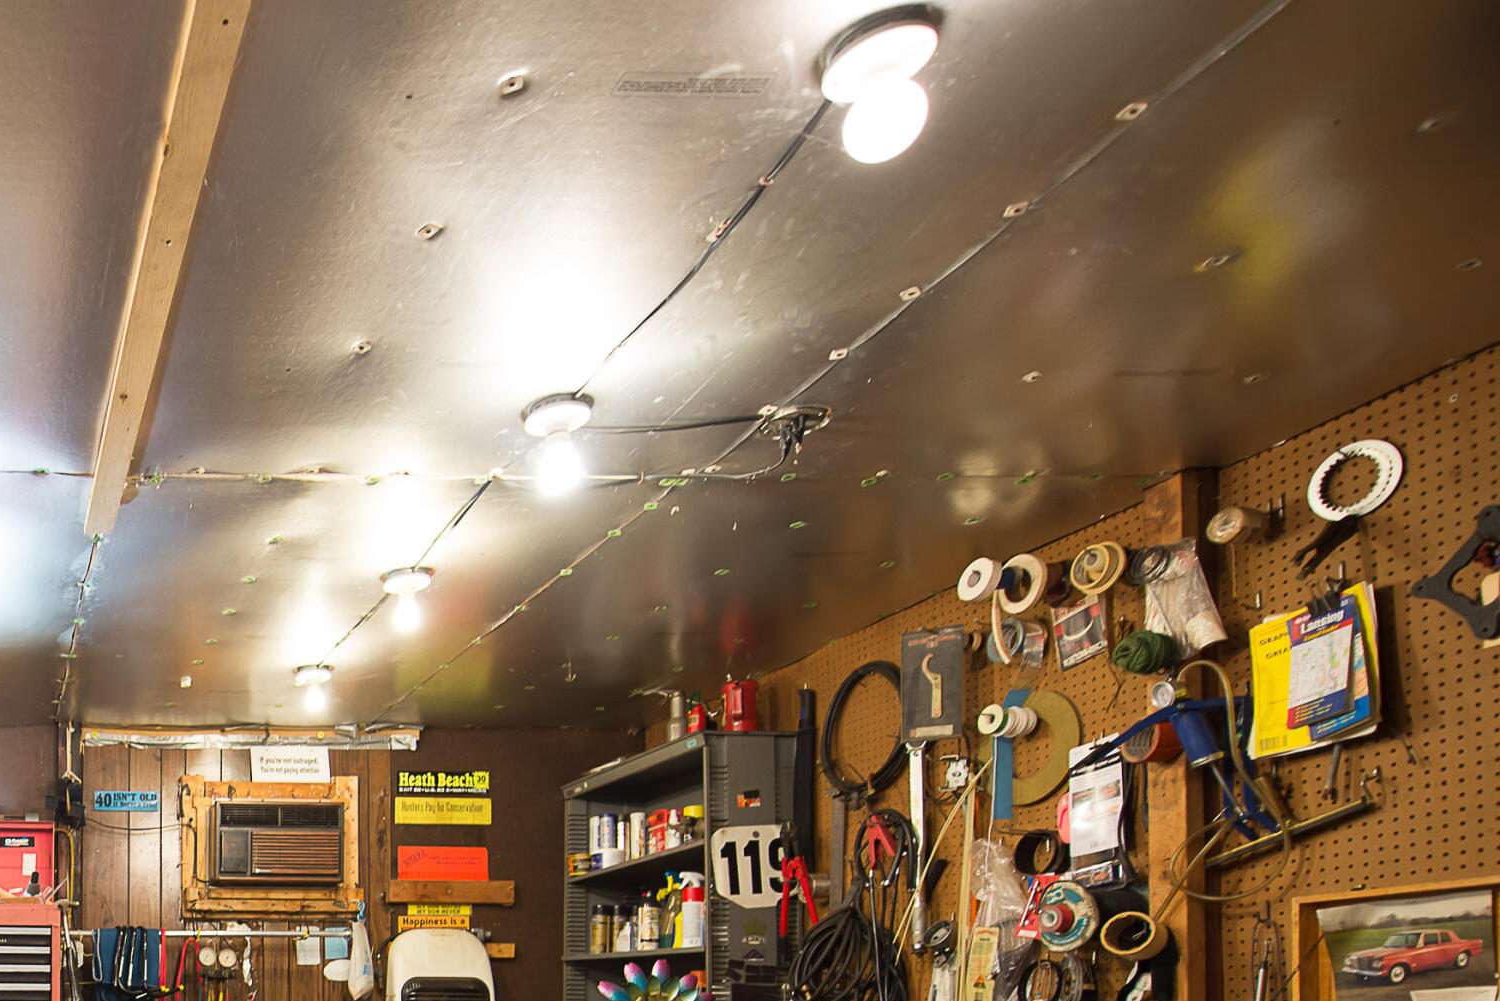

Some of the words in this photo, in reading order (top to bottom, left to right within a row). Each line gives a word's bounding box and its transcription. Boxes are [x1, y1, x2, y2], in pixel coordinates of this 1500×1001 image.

[1299, 609, 1345, 635] Lansing
[398, 771, 436, 788] Heath
[436, 771, 474, 788] Beach
[95, 792, 112, 808] 40
[113, 792, 137, 801] ISN'T
[139, 793, 158, 802] OLD
[401, 801, 425, 813] Hunters
[425, 801, 437, 815] Pay
[436, 801, 445, 813] for
[445, 801, 485, 813] Conservation
[720, 837, 797, 896] 119
[402, 917, 448, 927] Happiness
[449, 917, 458, 926] is
